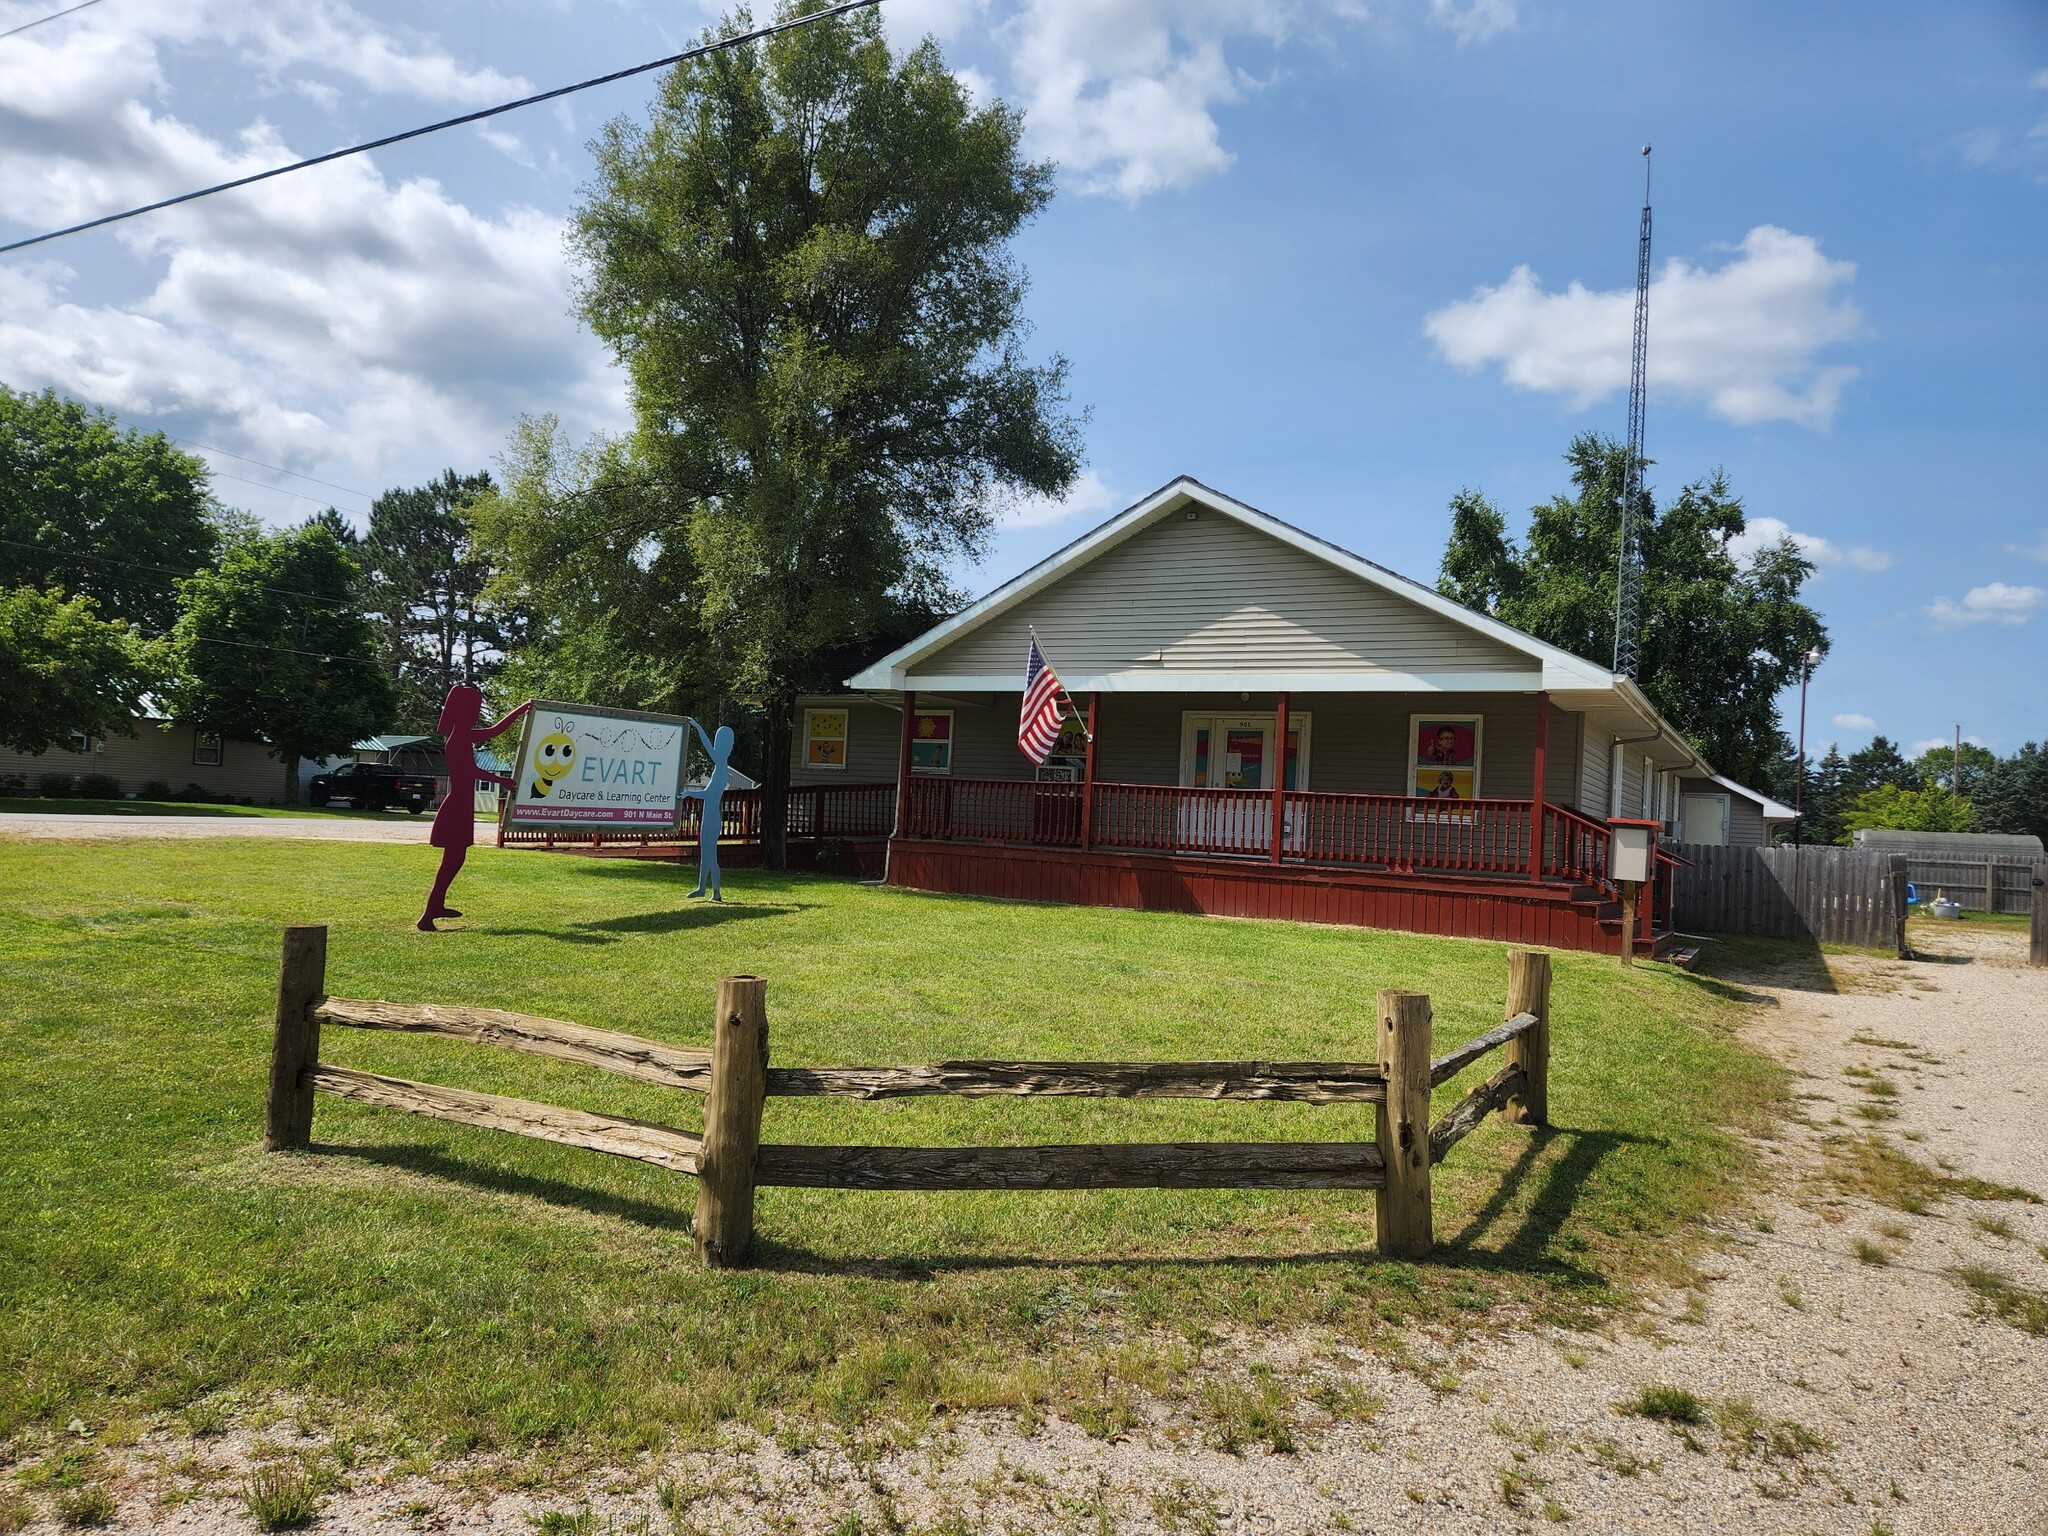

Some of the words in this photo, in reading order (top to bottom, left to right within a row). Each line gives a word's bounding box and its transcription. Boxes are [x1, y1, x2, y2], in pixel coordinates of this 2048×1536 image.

[581, 756, 662, 786] EVART
[558, 788, 595, 802] Daycare
[597, 790, 604, 801] &
[606, 791, 642, 805] Learning
[644, 792, 671, 803] Center
[516, 808, 614, 819] www.EvartDaycare.com
[623, 810, 637, 818] 901
[638, 810, 645, 818] N
[646, 811, 662, 819] Main
[663, 811, 673, 819] St.
